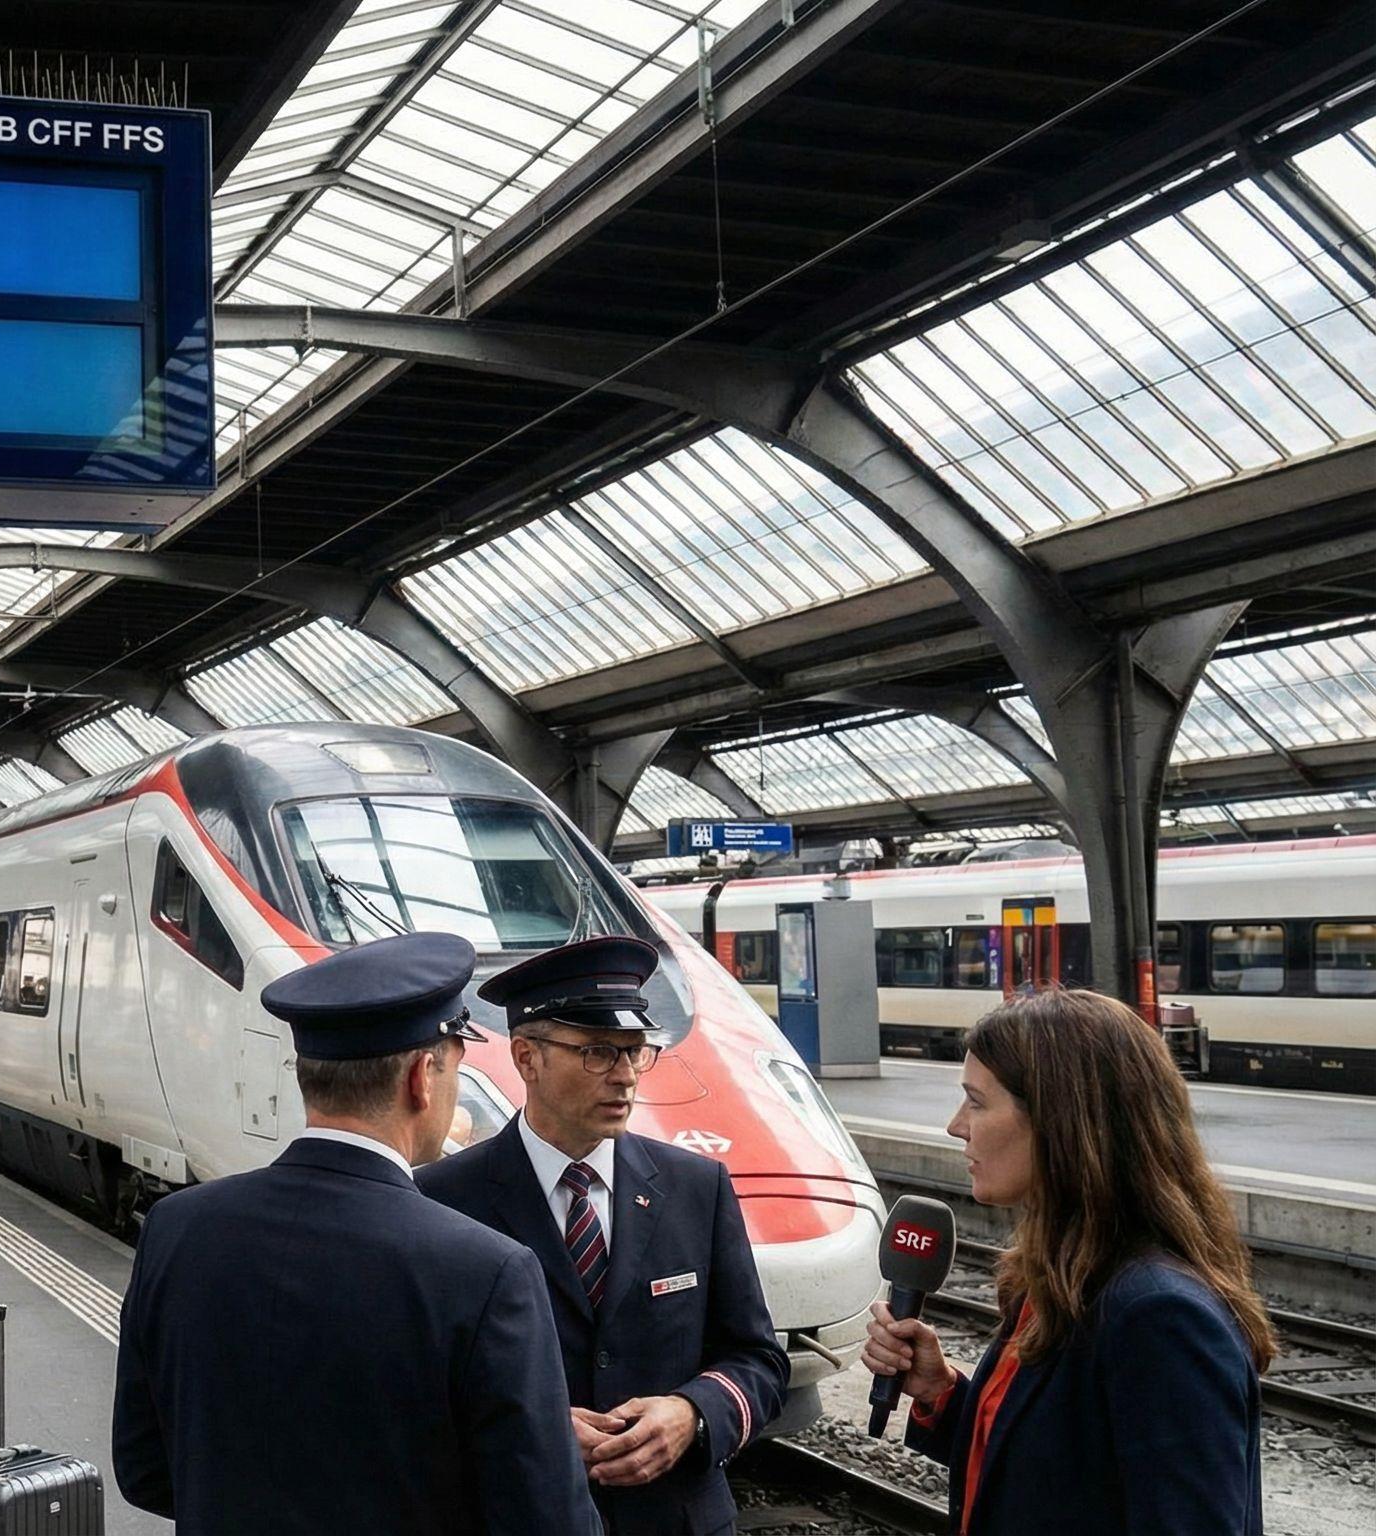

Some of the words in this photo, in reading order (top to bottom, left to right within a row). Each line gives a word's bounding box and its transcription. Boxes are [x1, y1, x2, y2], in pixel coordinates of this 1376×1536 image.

[28, 118, 93, 147] CFF
[103, 123, 164, 153] FFS
[944, 927, 953, 947] 1
[895, 1229, 933, 1251] SRF
